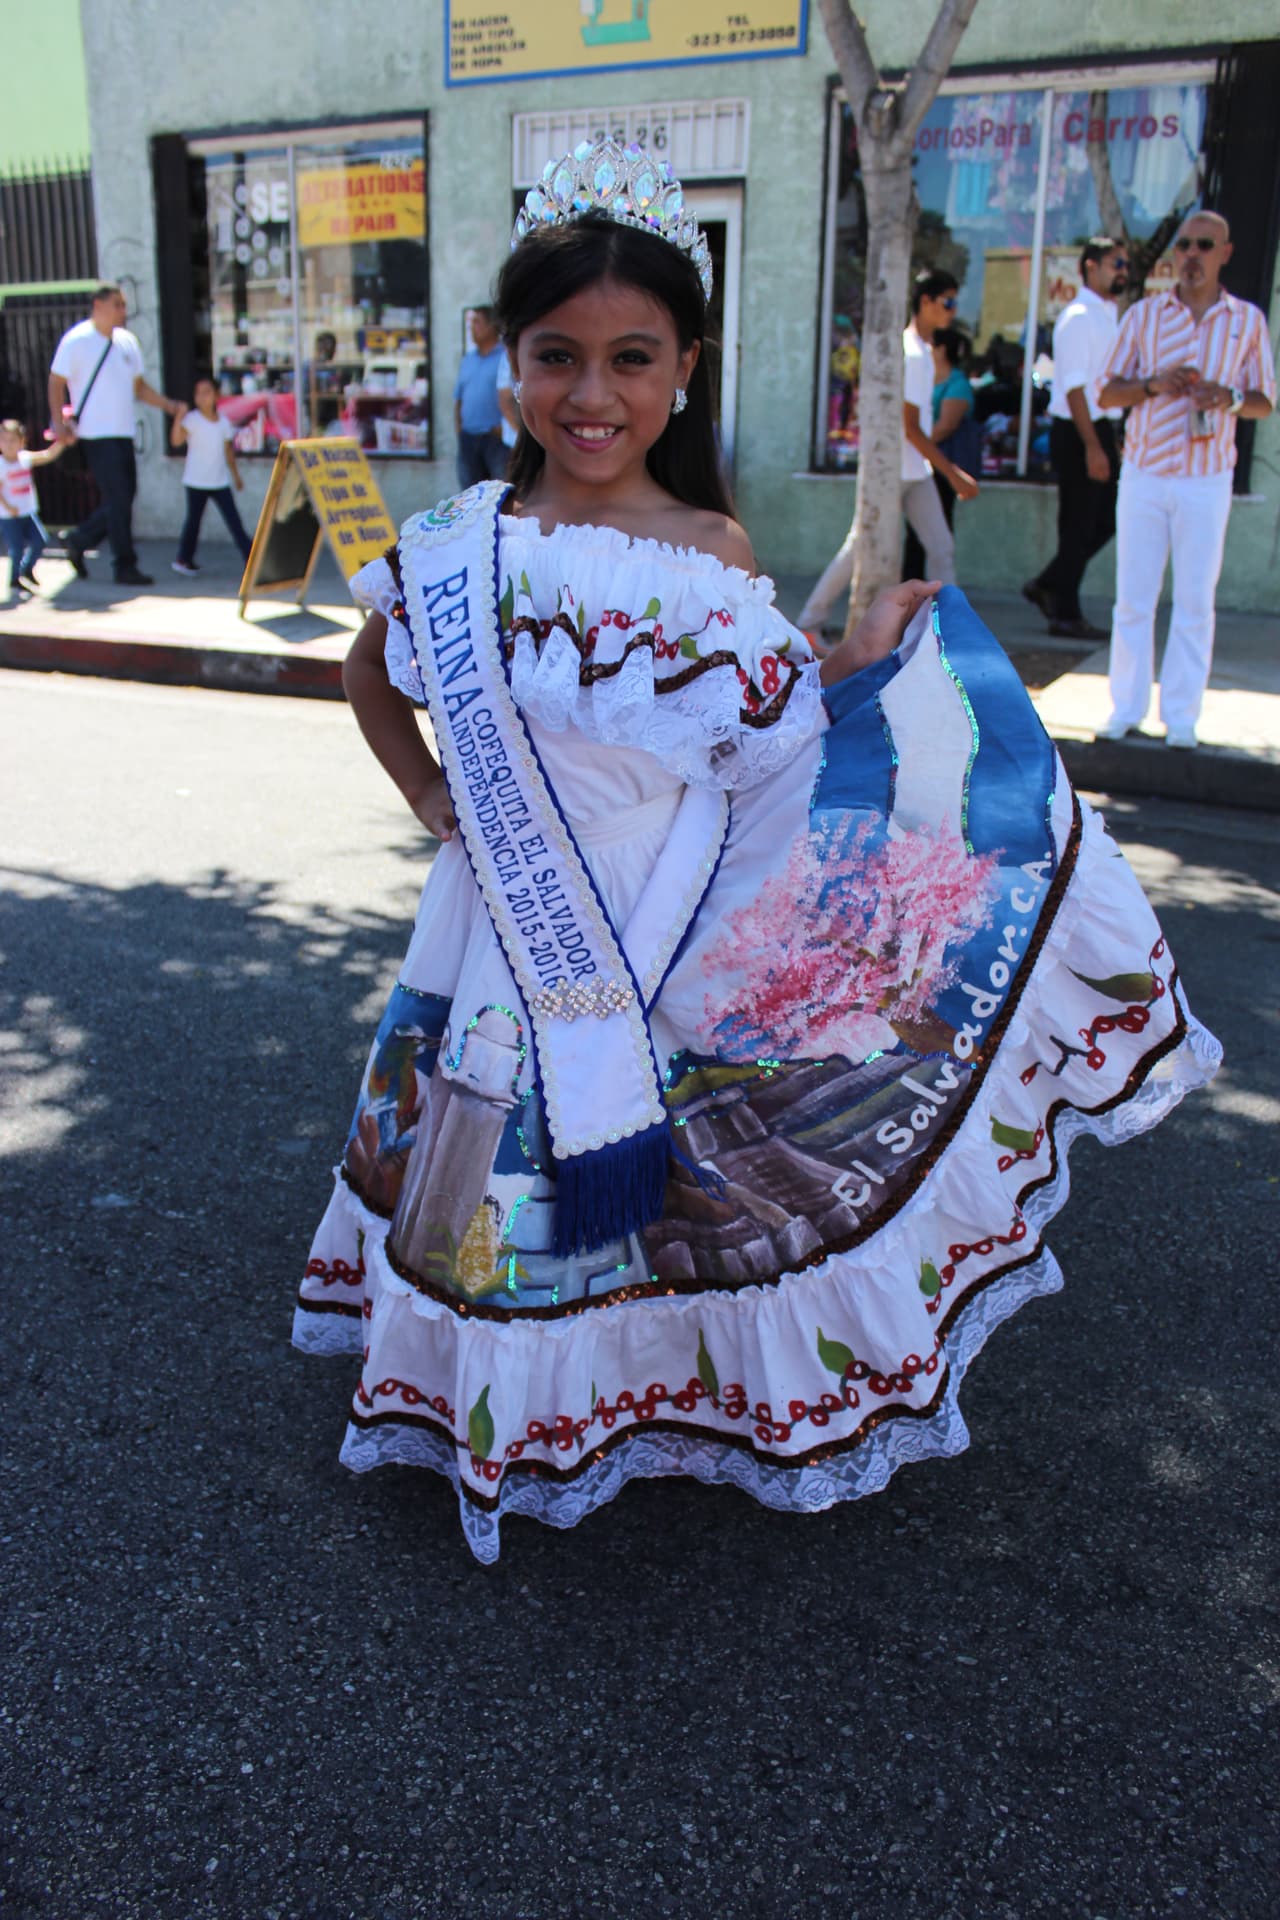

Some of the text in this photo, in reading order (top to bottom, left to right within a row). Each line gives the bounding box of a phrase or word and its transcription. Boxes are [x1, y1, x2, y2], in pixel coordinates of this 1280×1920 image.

[1063, 112, 1180, 143] Carros
[303, 170, 425, 203] ALTERATIONS
[330, 213, 396, 236] REPAIR
[422, 566, 484, 723] REINA
[451, 718, 568, 989] INDEPENDENCIA 2015-2016
[472, 708, 597, 980] COFEQUITA EL SALVADOR
[832, 1160, 885, 1208] El
